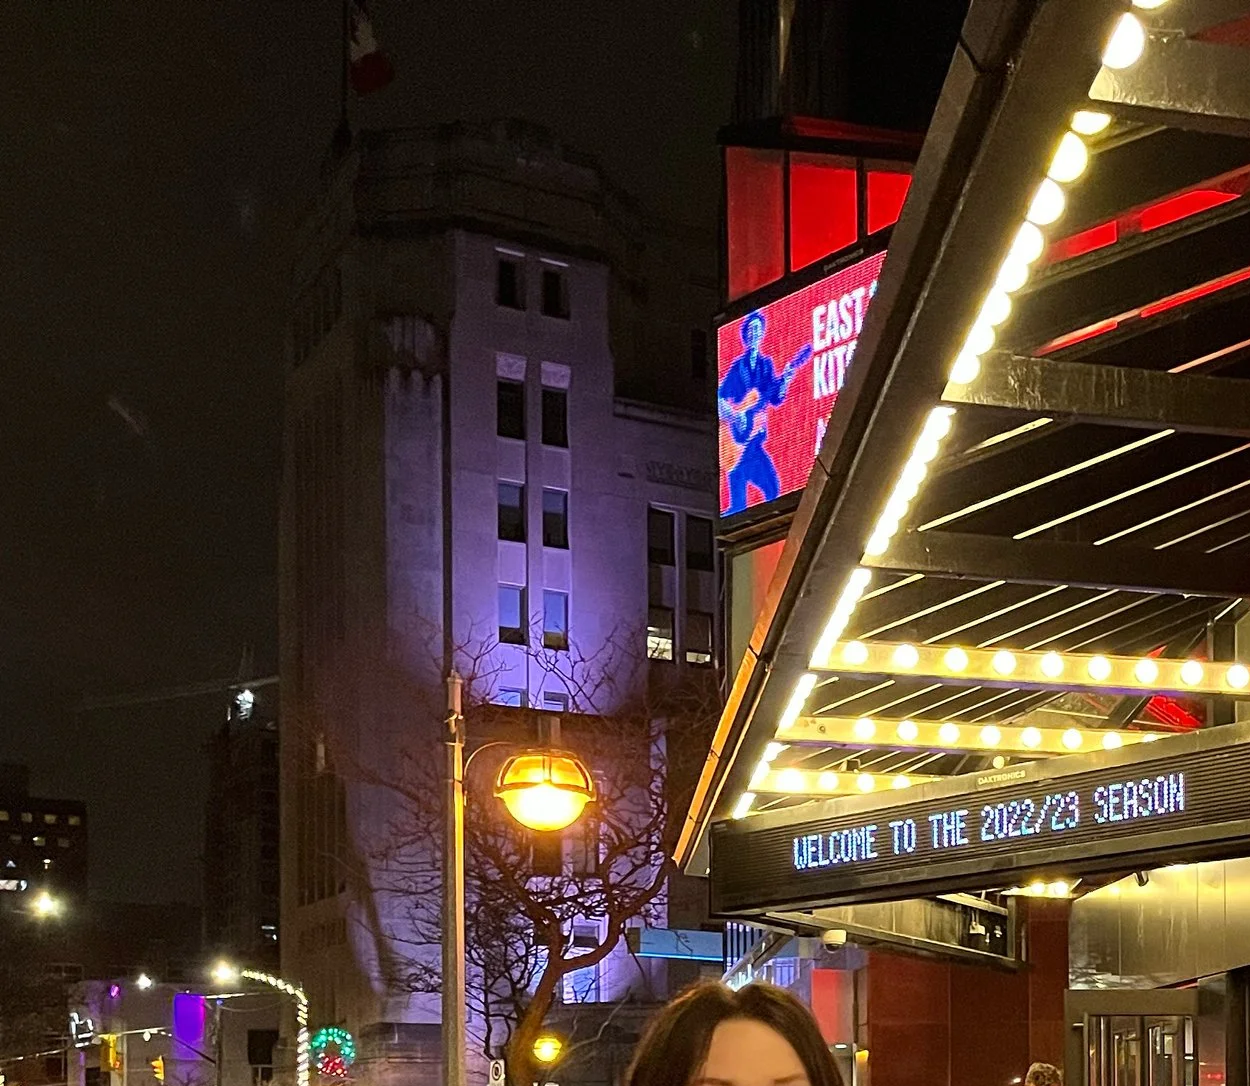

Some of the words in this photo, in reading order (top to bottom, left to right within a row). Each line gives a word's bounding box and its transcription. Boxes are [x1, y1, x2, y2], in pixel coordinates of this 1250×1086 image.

[812, 279, 878, 350] EAST
[793, 824, 879, 870] WELCOME
[888, 818, 916, 855] TO
[928, 809, 969, 849] THE
[981, 791, 1079, 842] 2022/23
[1094, 772, 1185, 824] SEASON
